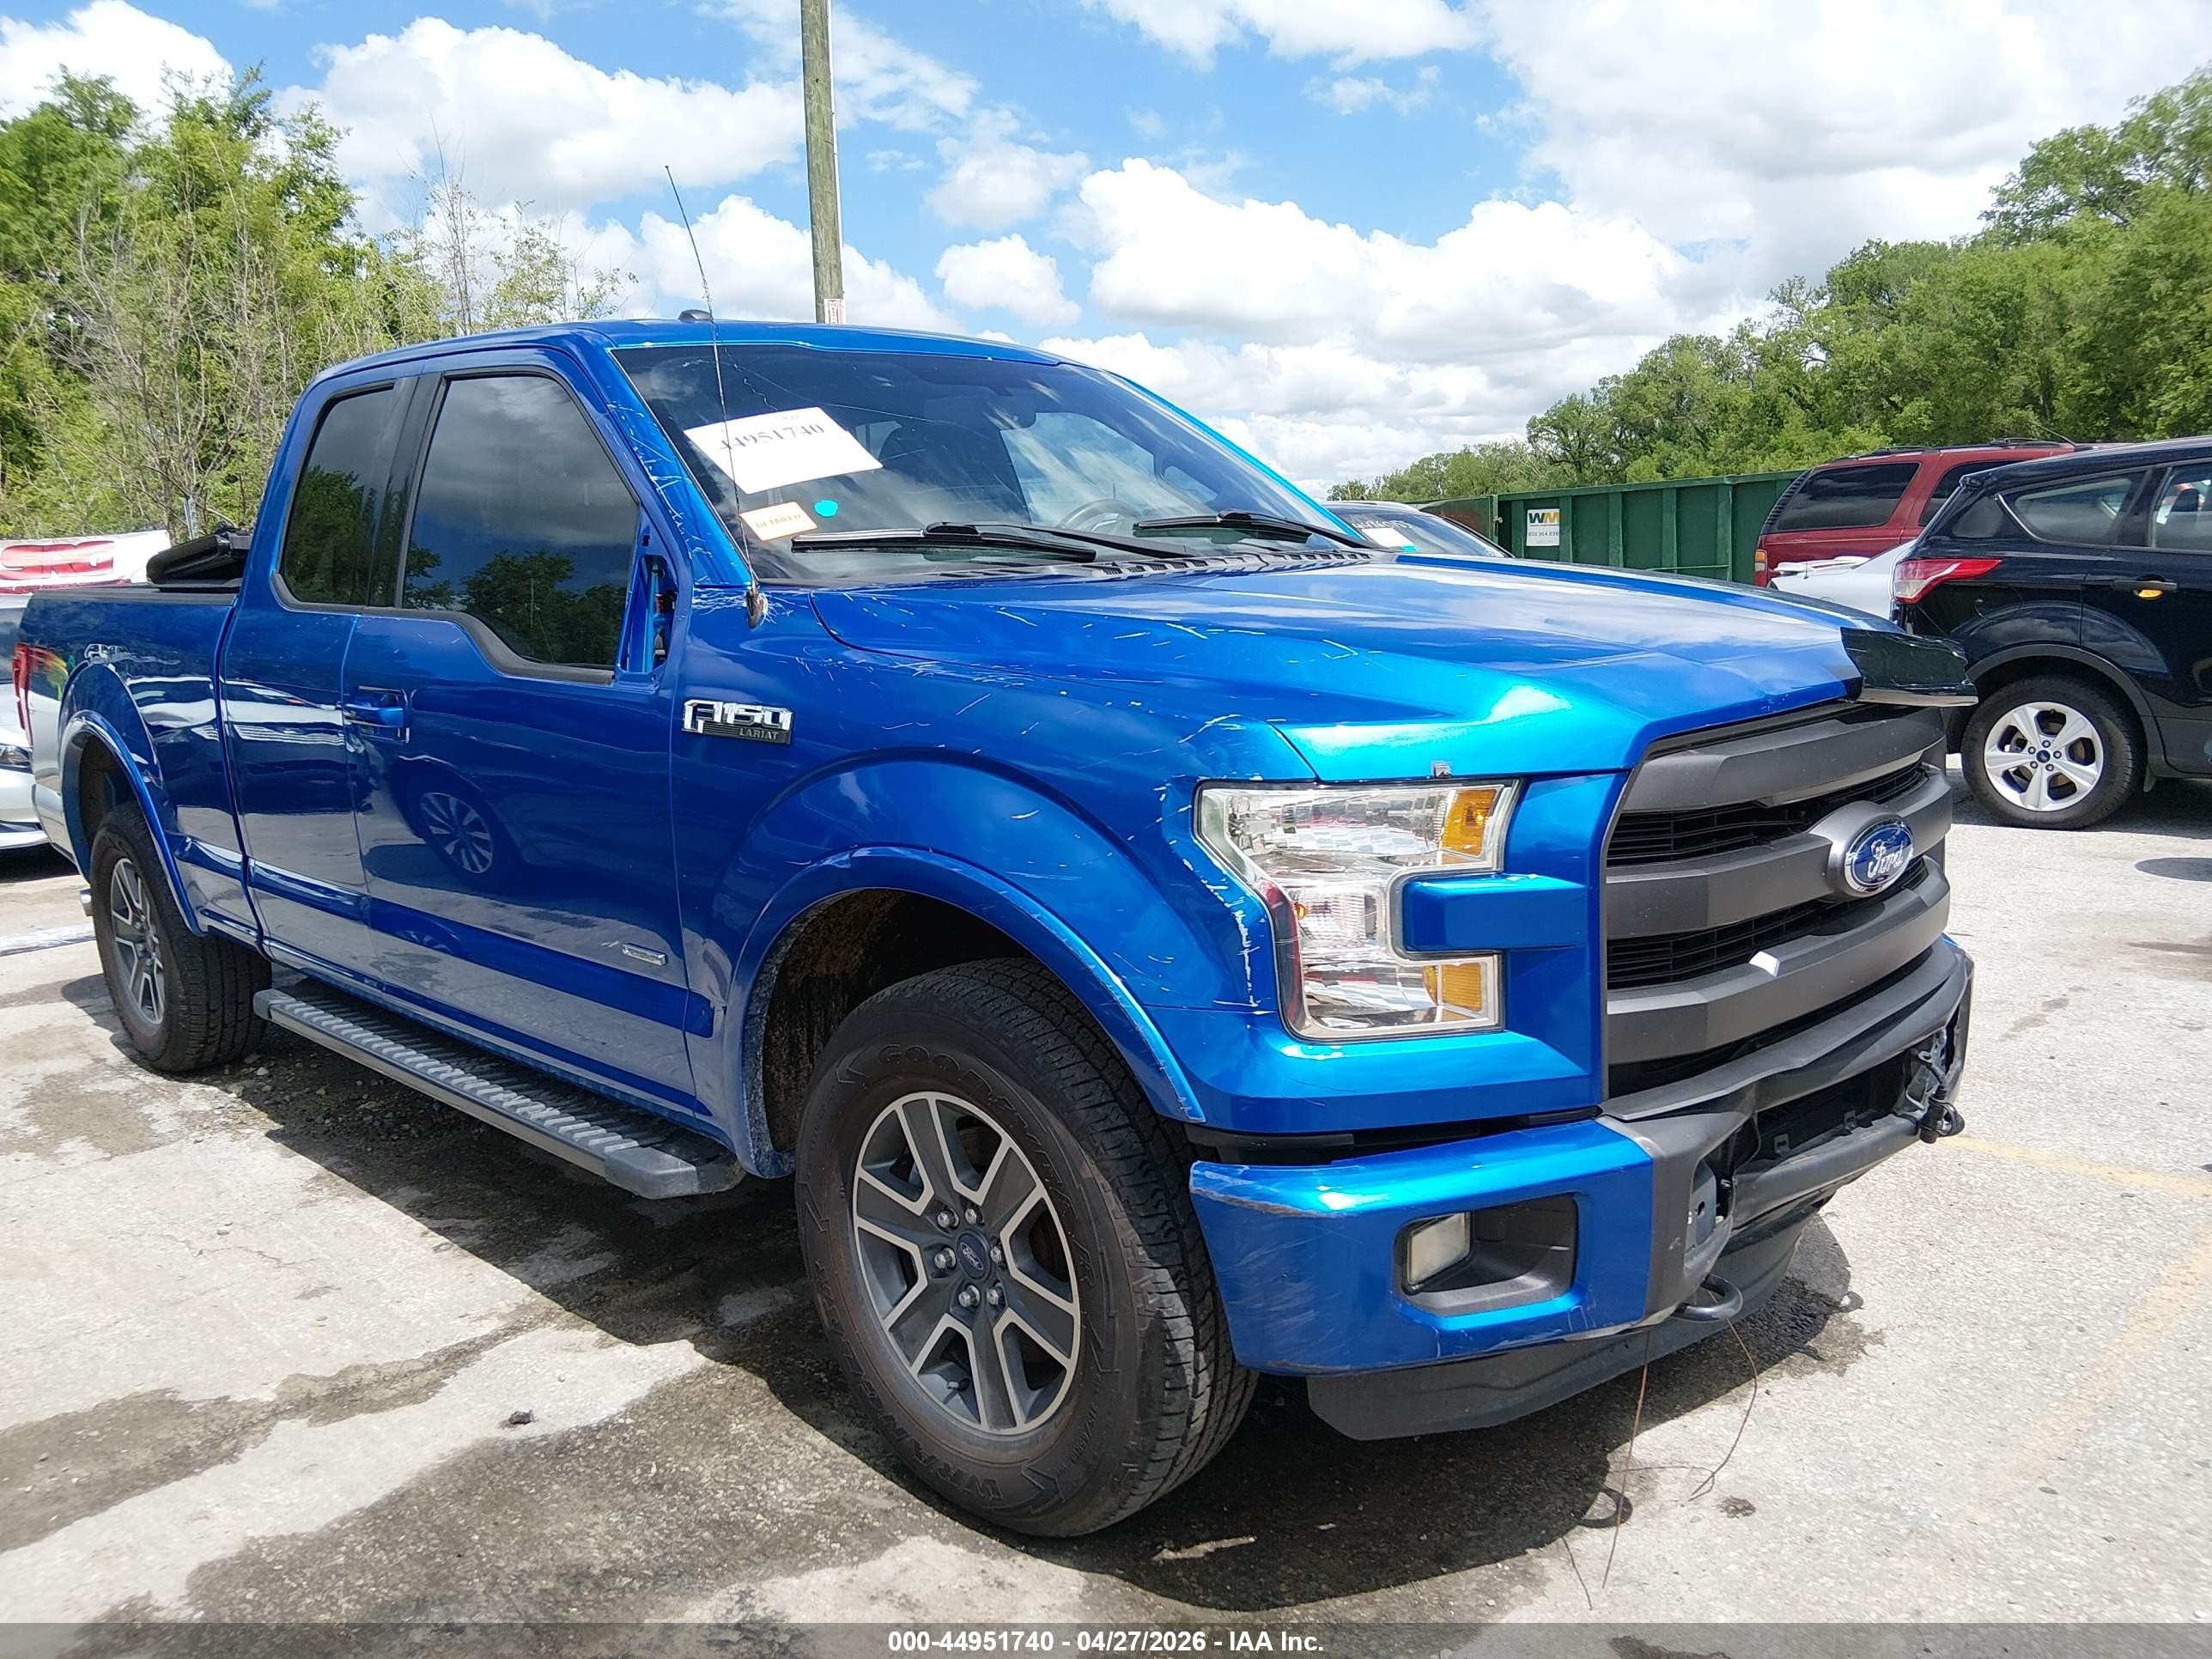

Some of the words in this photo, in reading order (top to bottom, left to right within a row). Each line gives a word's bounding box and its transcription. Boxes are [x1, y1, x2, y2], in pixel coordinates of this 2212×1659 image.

[720, 424, 825, 450] 44951740
[1528, 512, 1560, 523] WM
[738, 727, 779, 740] LARIAT
[1867, 839, 1904, 878] Ford
